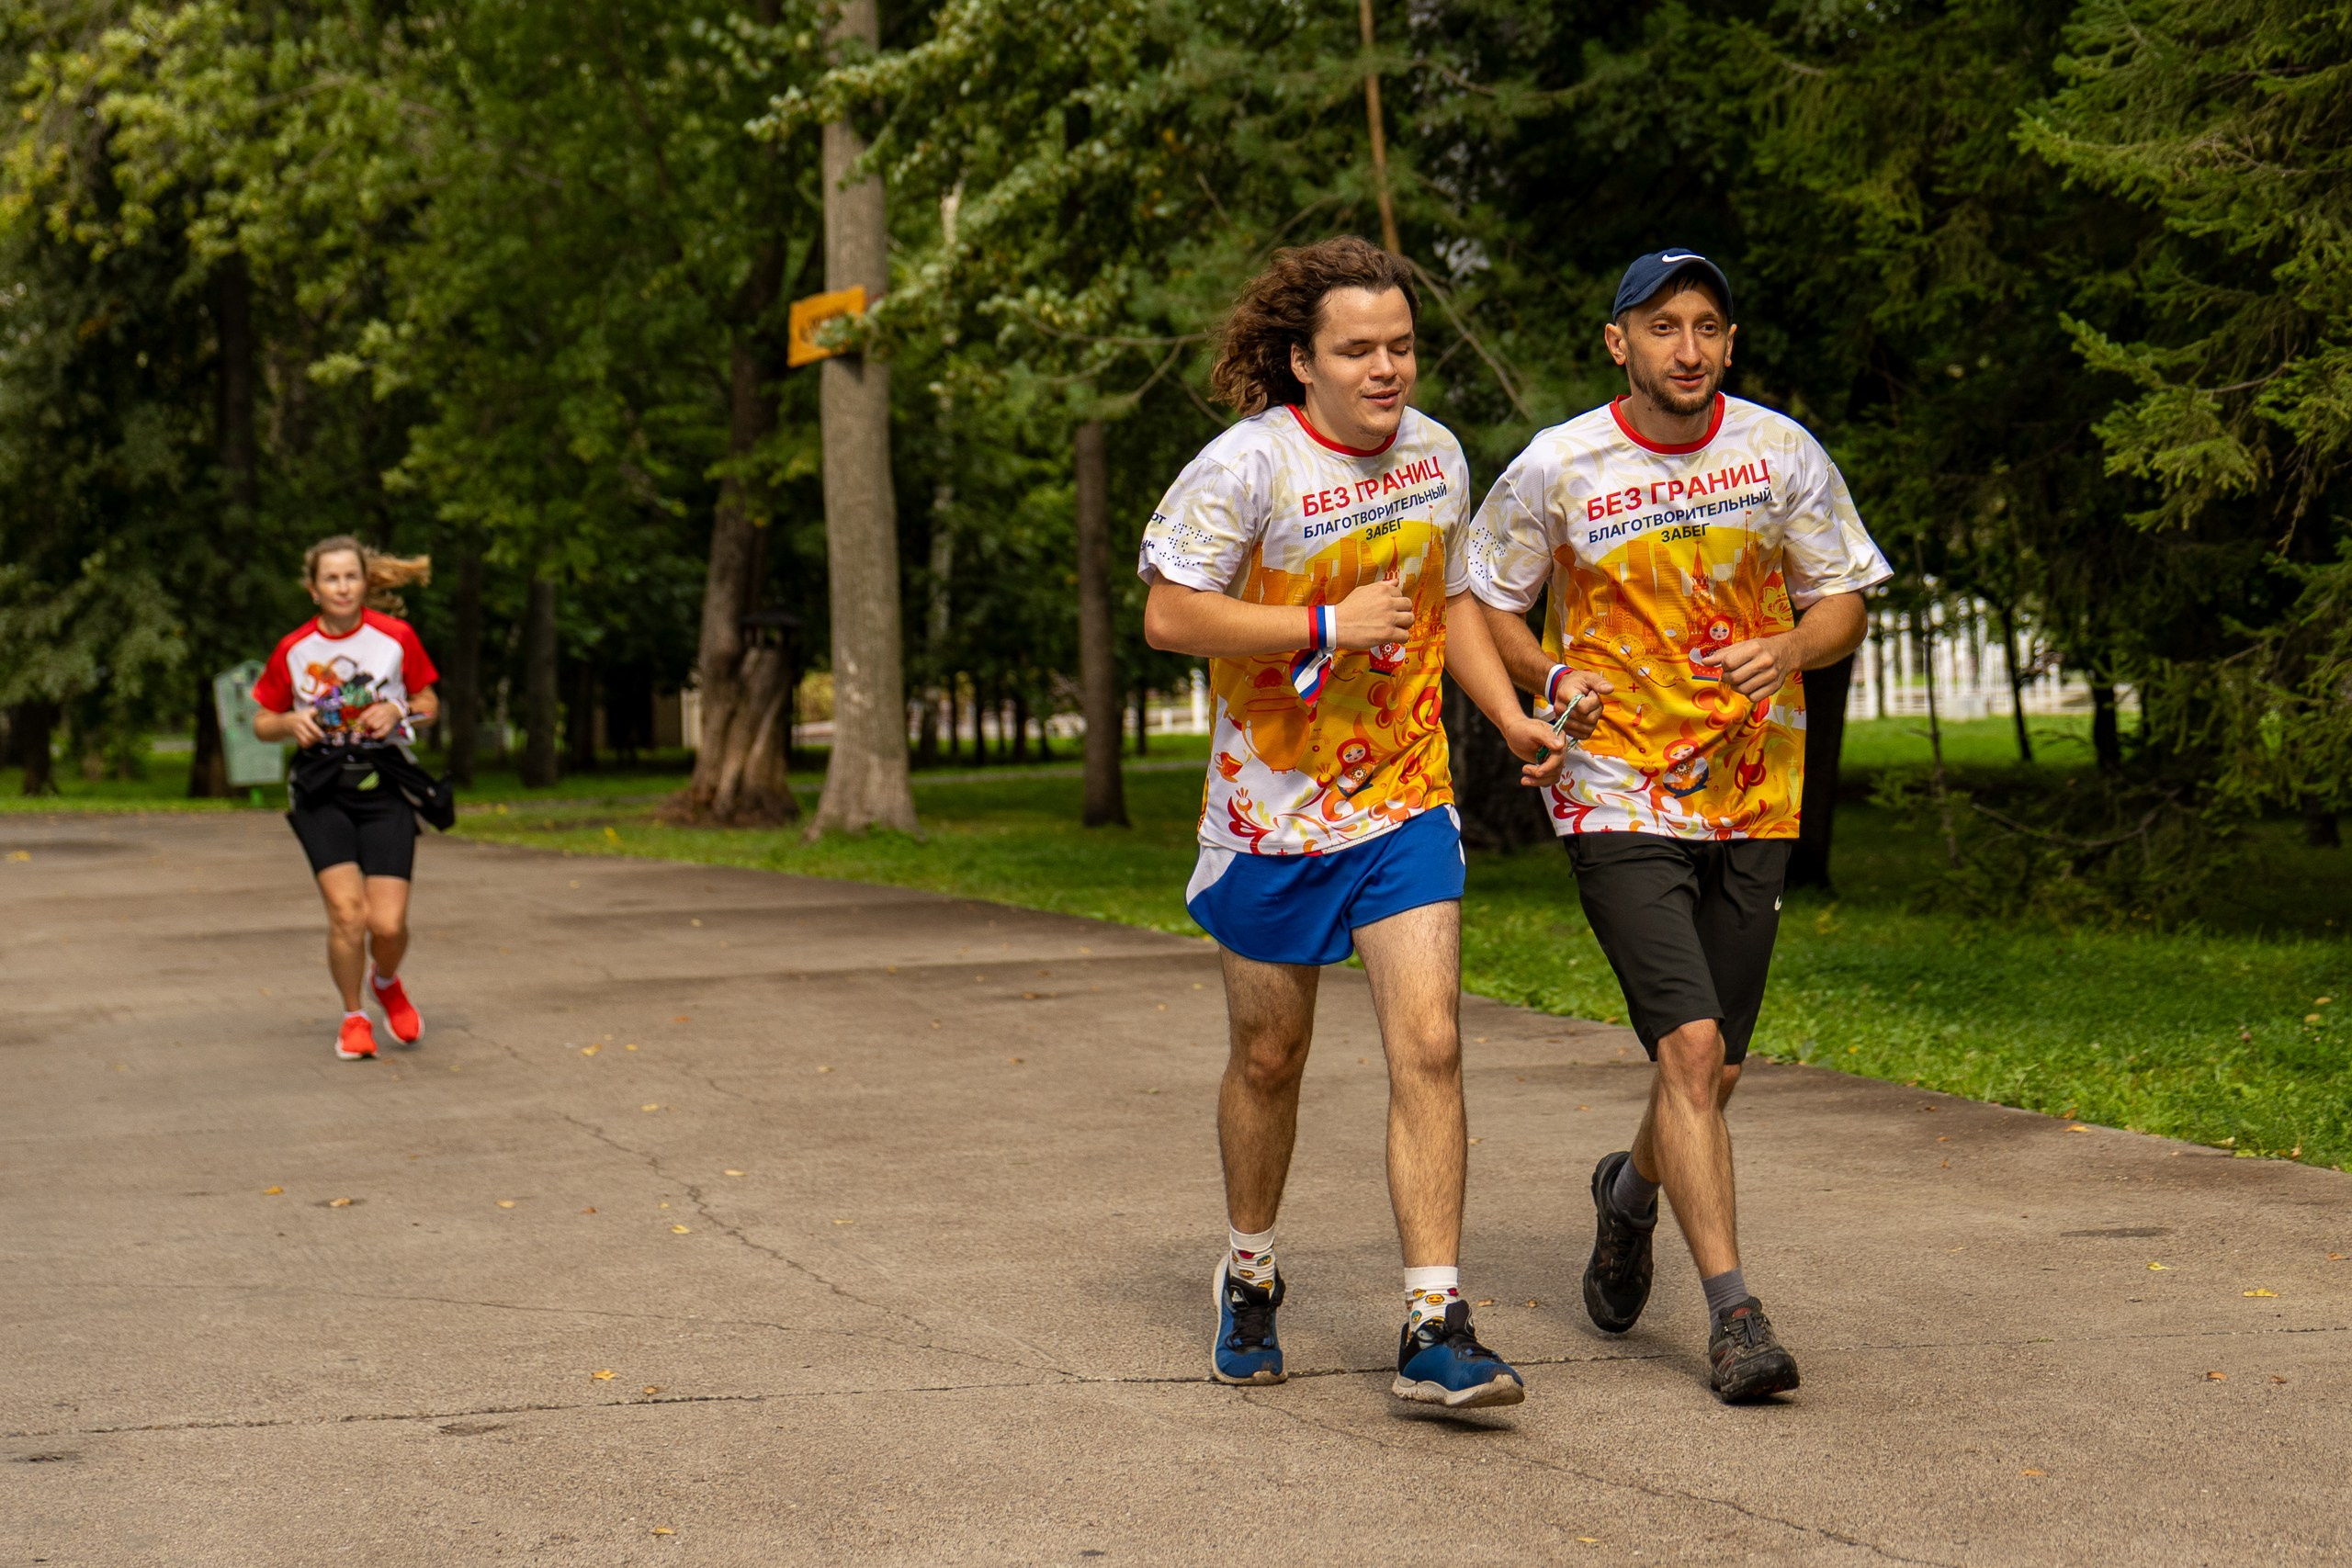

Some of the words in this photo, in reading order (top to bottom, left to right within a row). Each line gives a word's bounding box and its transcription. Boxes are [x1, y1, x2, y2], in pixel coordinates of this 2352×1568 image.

[1302, 486, 1351, 517] БЕЗ
[1354, 456, 1445, 502] ГРАНИЦ
[1304, 481, 1448, 539] БЛАГОТВОРИТЕЛЬНЫЙ
[1587, 487, 1643, 522] БЕЗ
[1650, 458, 1771, 505] ГРАНИЦ
[1365, 516, 1405, 540] ЗАБЕГ
[1589, 487, 1773, 544] БЛАГОТВОРИТЕЛЬНЫЙ
[1660, 523, 1711, 543] ЗАБЕГ
